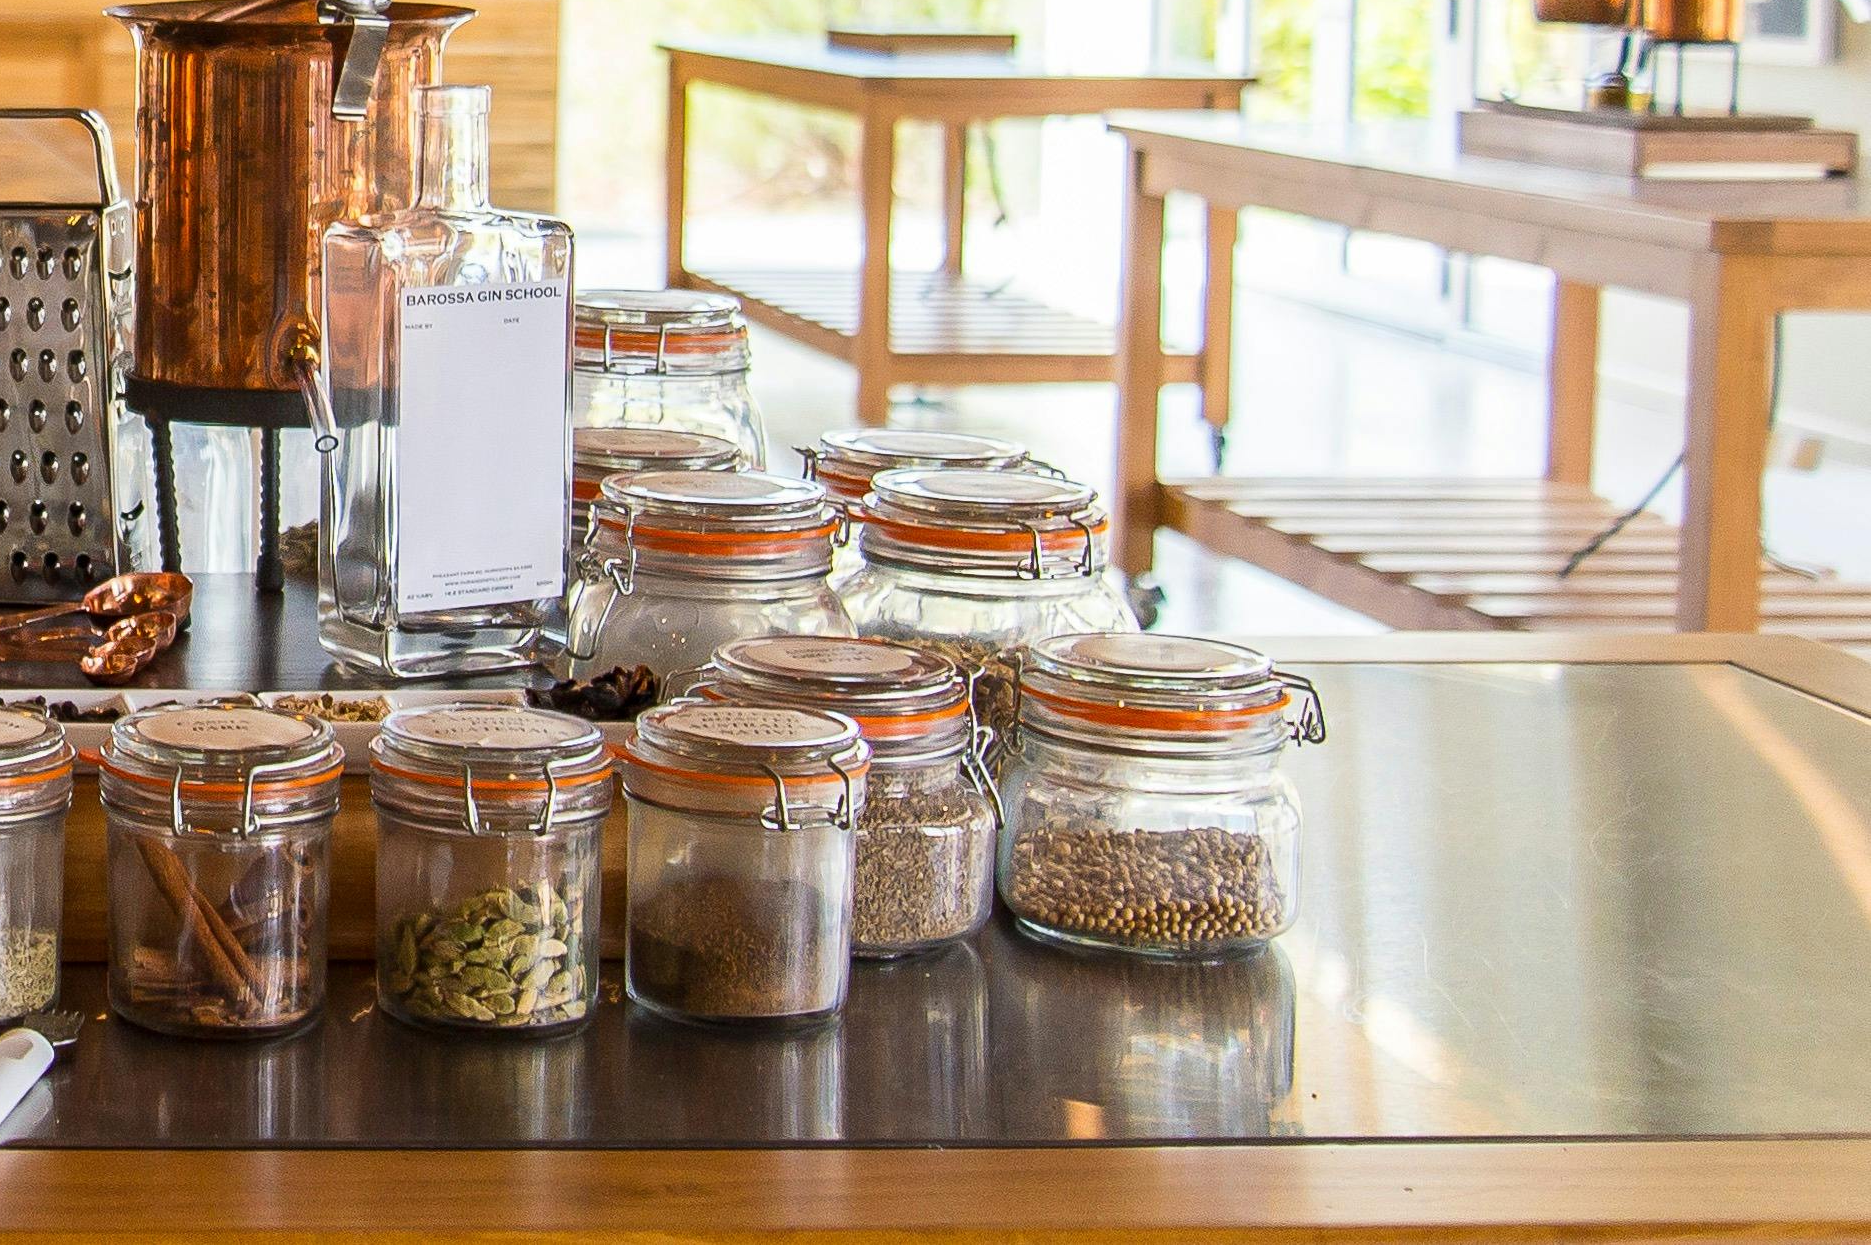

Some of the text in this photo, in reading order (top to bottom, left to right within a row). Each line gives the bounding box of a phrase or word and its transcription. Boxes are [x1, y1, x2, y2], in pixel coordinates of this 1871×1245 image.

[406, 286, 562, 307] BAROSSA GIN SCHOOL
